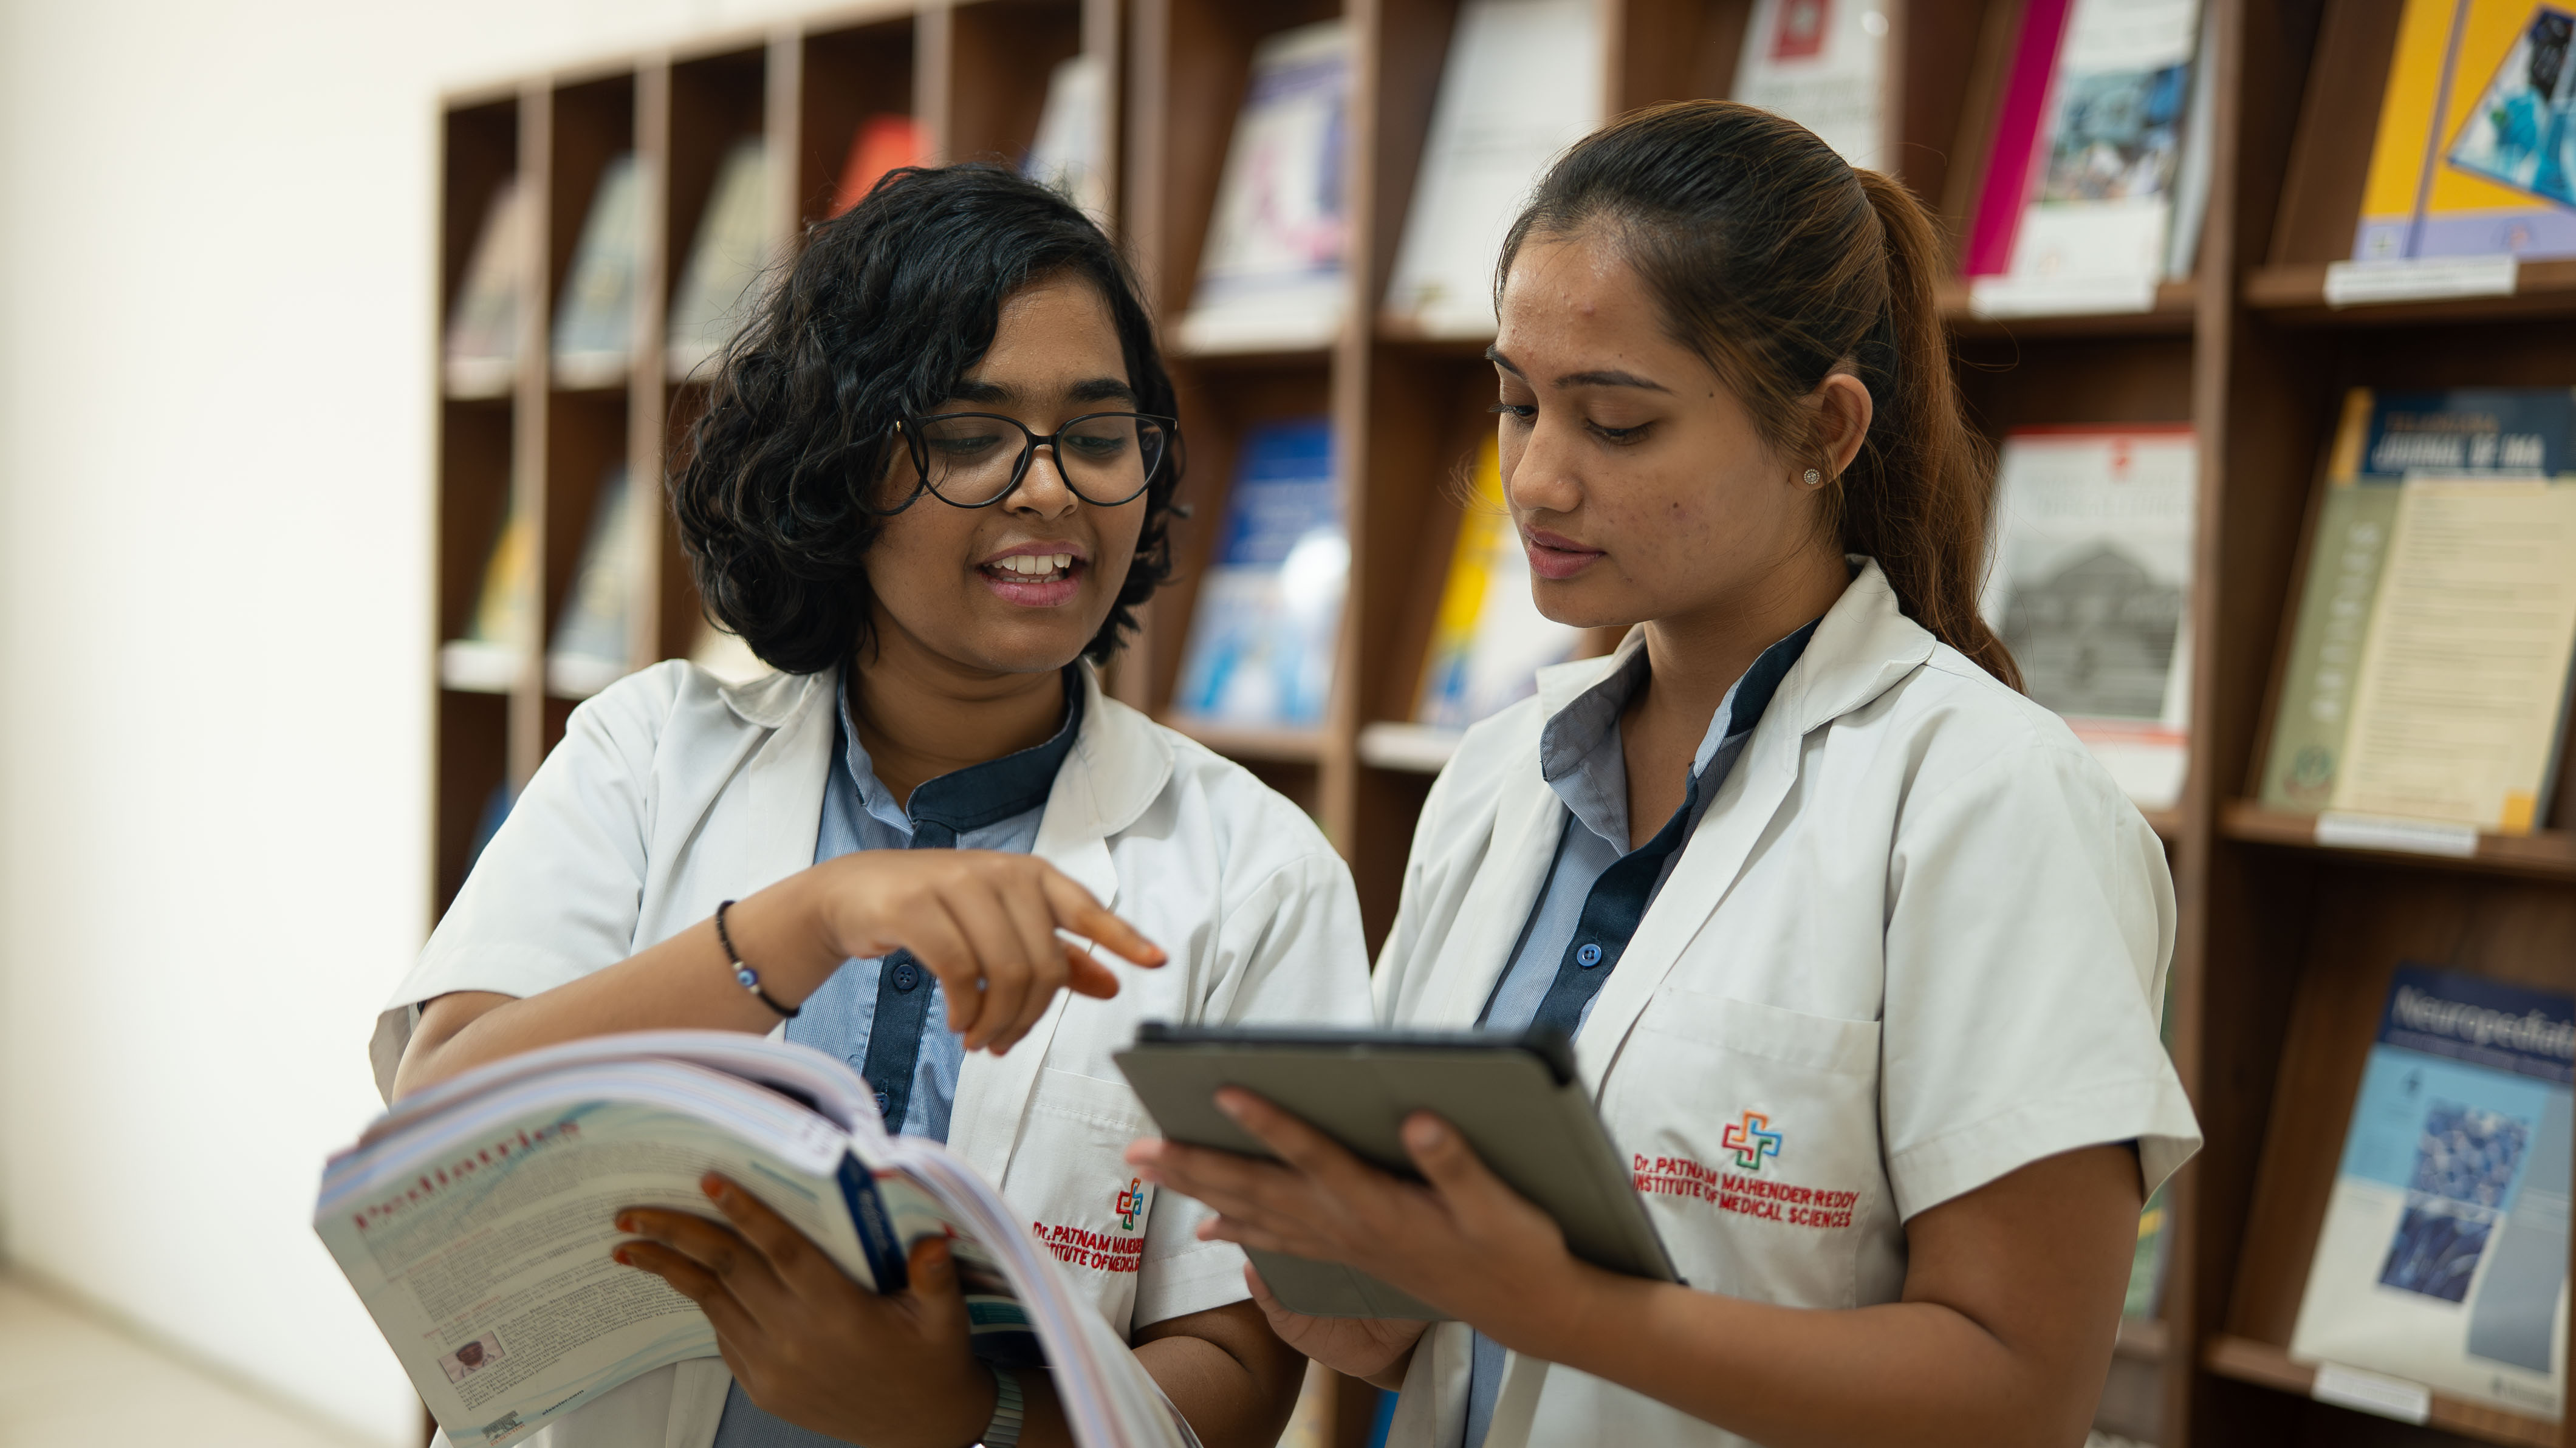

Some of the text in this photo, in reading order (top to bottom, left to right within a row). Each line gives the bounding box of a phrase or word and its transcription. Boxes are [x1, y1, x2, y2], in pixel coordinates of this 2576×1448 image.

[2372, 432, 2463, 470] JOURNAL
[352, 1120, 580, 1231] Pediatrics
[1633, 1172, 1852, 1228] INSTITUTE OF MEDICAL SCIENCES
[1813, 1189, 1860, 1210] REDDY
[1091, 1251, 1109, 1271] OF
